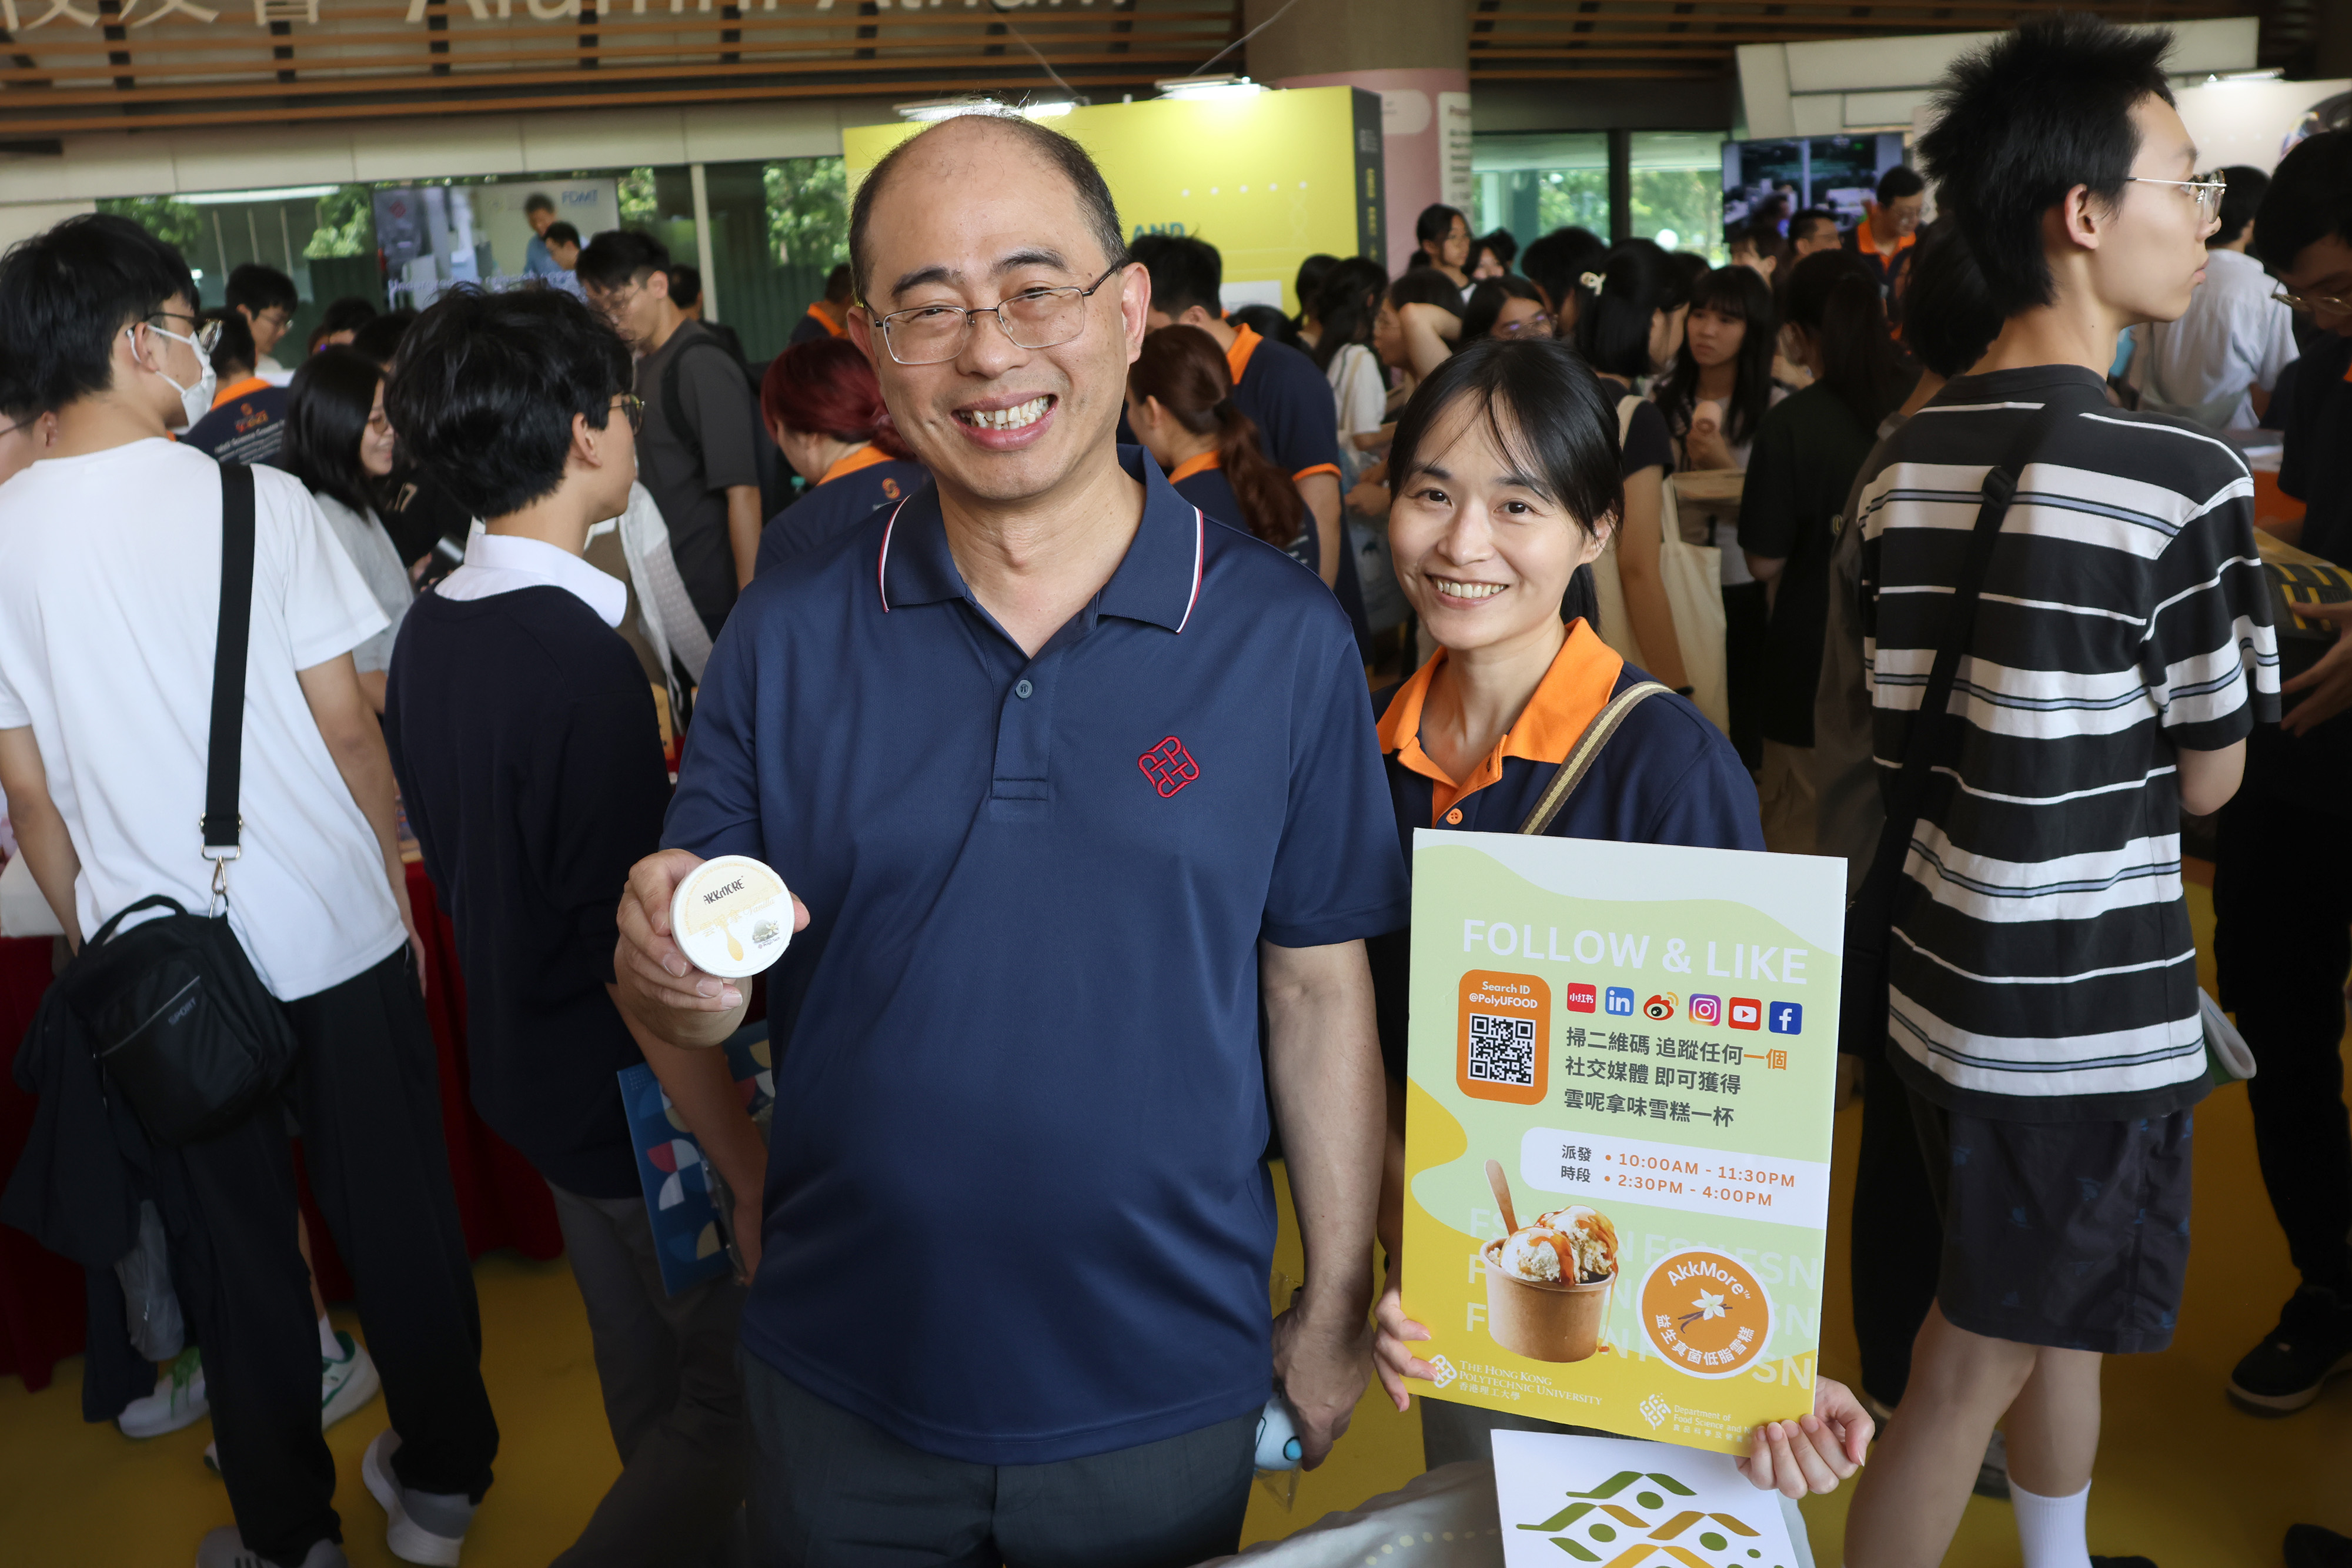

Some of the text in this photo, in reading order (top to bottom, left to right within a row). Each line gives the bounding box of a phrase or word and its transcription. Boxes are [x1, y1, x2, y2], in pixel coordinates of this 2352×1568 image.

[743, 898, 775, 916] Vanilla
[700, 909, 743, 937] 雲呢拿
[1464, 919, 1808, 985] FOLLOW & LIKE
[1469, 992, 1538, 1009] @PolyUFOOD
[1482, 981, 1531, 995] Search ID
[168, 997, 196, 1025] SPORT
[1566, 1027, 1788, 1071] 掃二維碼 追蹤任何一個
[1565, 1055, 1741, 1095] 社交媒體 即可獲得
[1564, 1088, 1735, 1128] 雲呢拿味雪糕一杯
[1561, 1144, 1592, 1162] 派發
[1561, 1165, 1591, 1183] 時段
[1619, 1153, 1699, 1175] 10:00AM
[1718, 1166, 1795, 1188] 11:30PM
[1618, 1174, 1683, 1195] 2:30PM
[1702, 1186, 1772, 1206] 4:00PM
[1655, 1313, 1755, 1366] 益生真菌低脂雪糕
[1459, 1360, 1552, 1386] THE HONG KONG
[1459, 1370, 1603, 1406] POLYTECHNIC UNIVERSITY
[1459, 1382, 1521, 1401] 香港理工大學
[1673, 1413, 1693, 1424] Food
[1695, 1417, 1724, 1430] Science
[1726, 1425, 1742, 1433] and
[1674, 1404, 1720, 1420] Department
